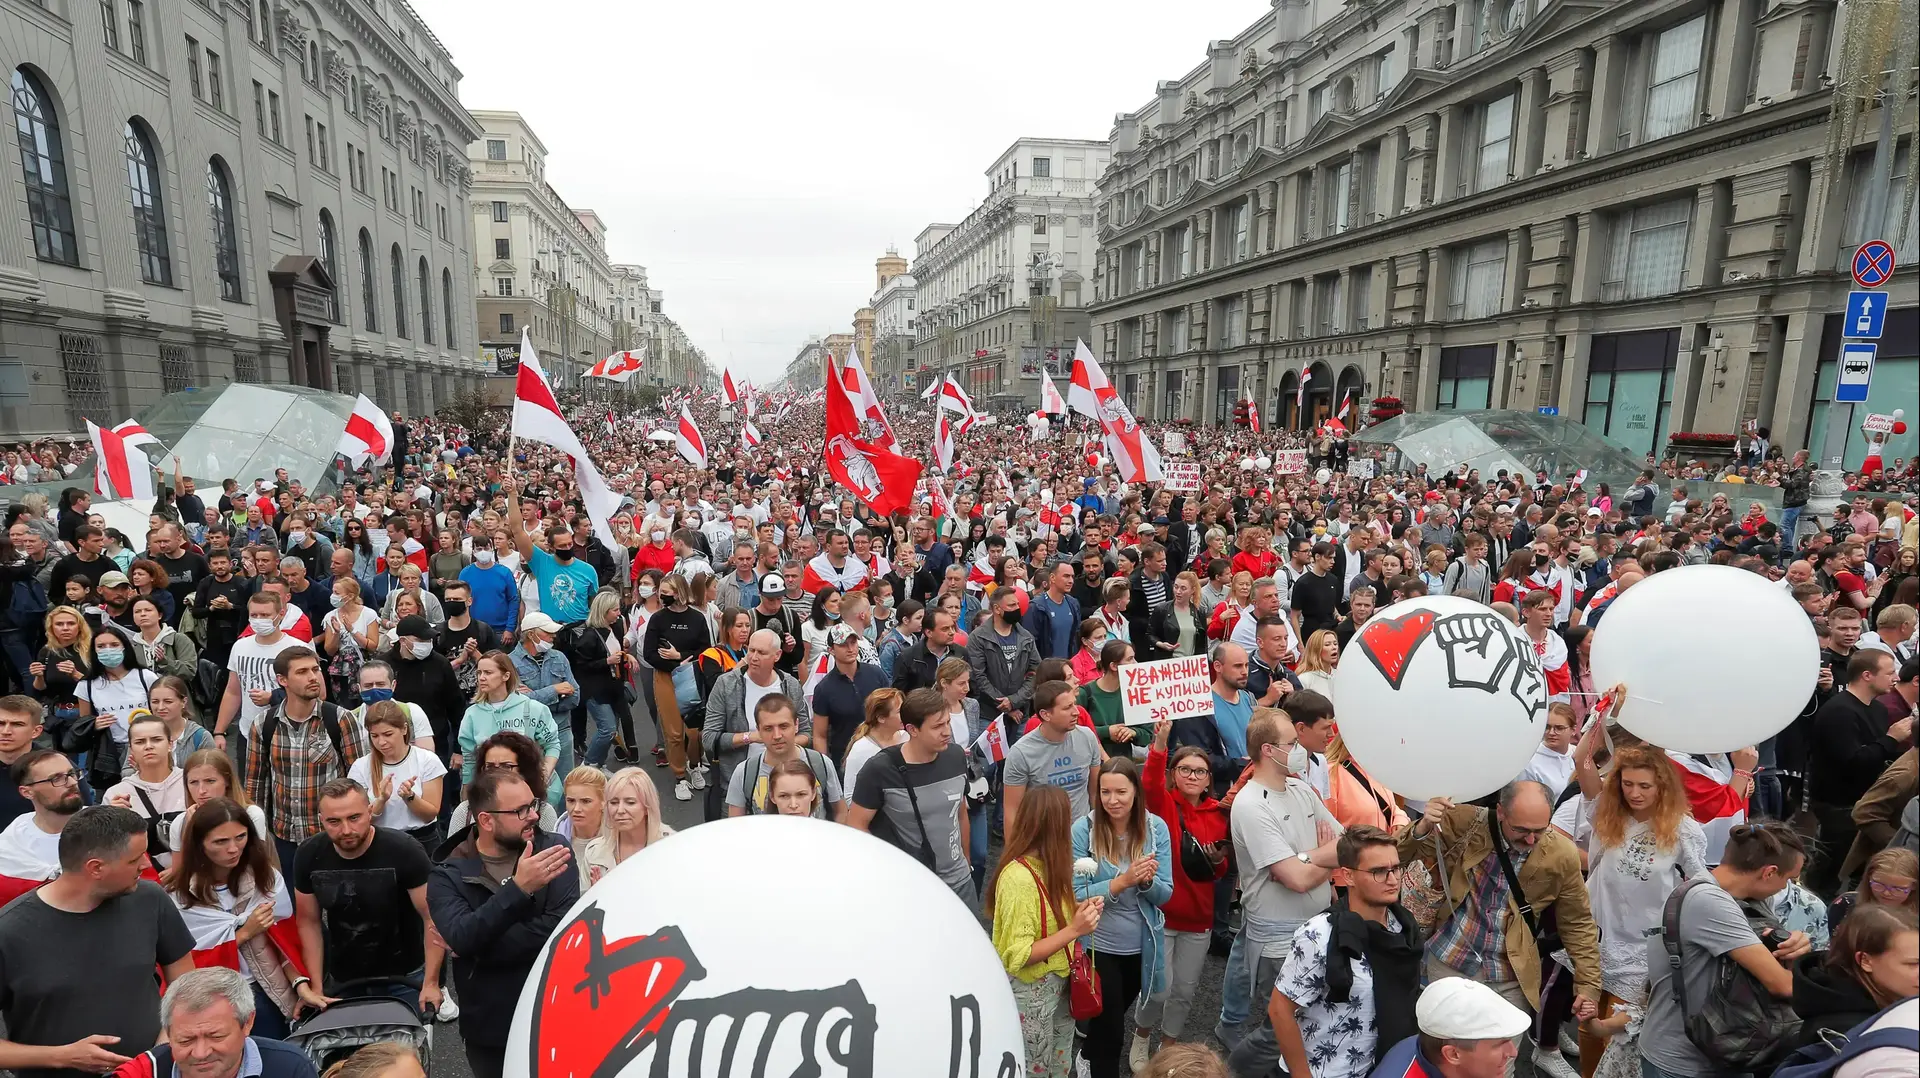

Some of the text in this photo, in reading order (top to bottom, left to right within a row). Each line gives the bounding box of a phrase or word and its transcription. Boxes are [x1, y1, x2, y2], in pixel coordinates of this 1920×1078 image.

[497, 346, 515, 355] SMILE
[499, 352, 516, 361] TIME
[1125, 657, 1209, 686] УВАЖЕНИЕ
[1127, 680, 1211, 707] НЕ КУПИШЬ
[95, 701, 147, 712] ALANC
[1150, 706, 1169, 720] ЗА
[1169, 698, 1195, 713] 100
[1054, 756, 1072, 768] NO
[1047, 773, 1083, 787] MORE
